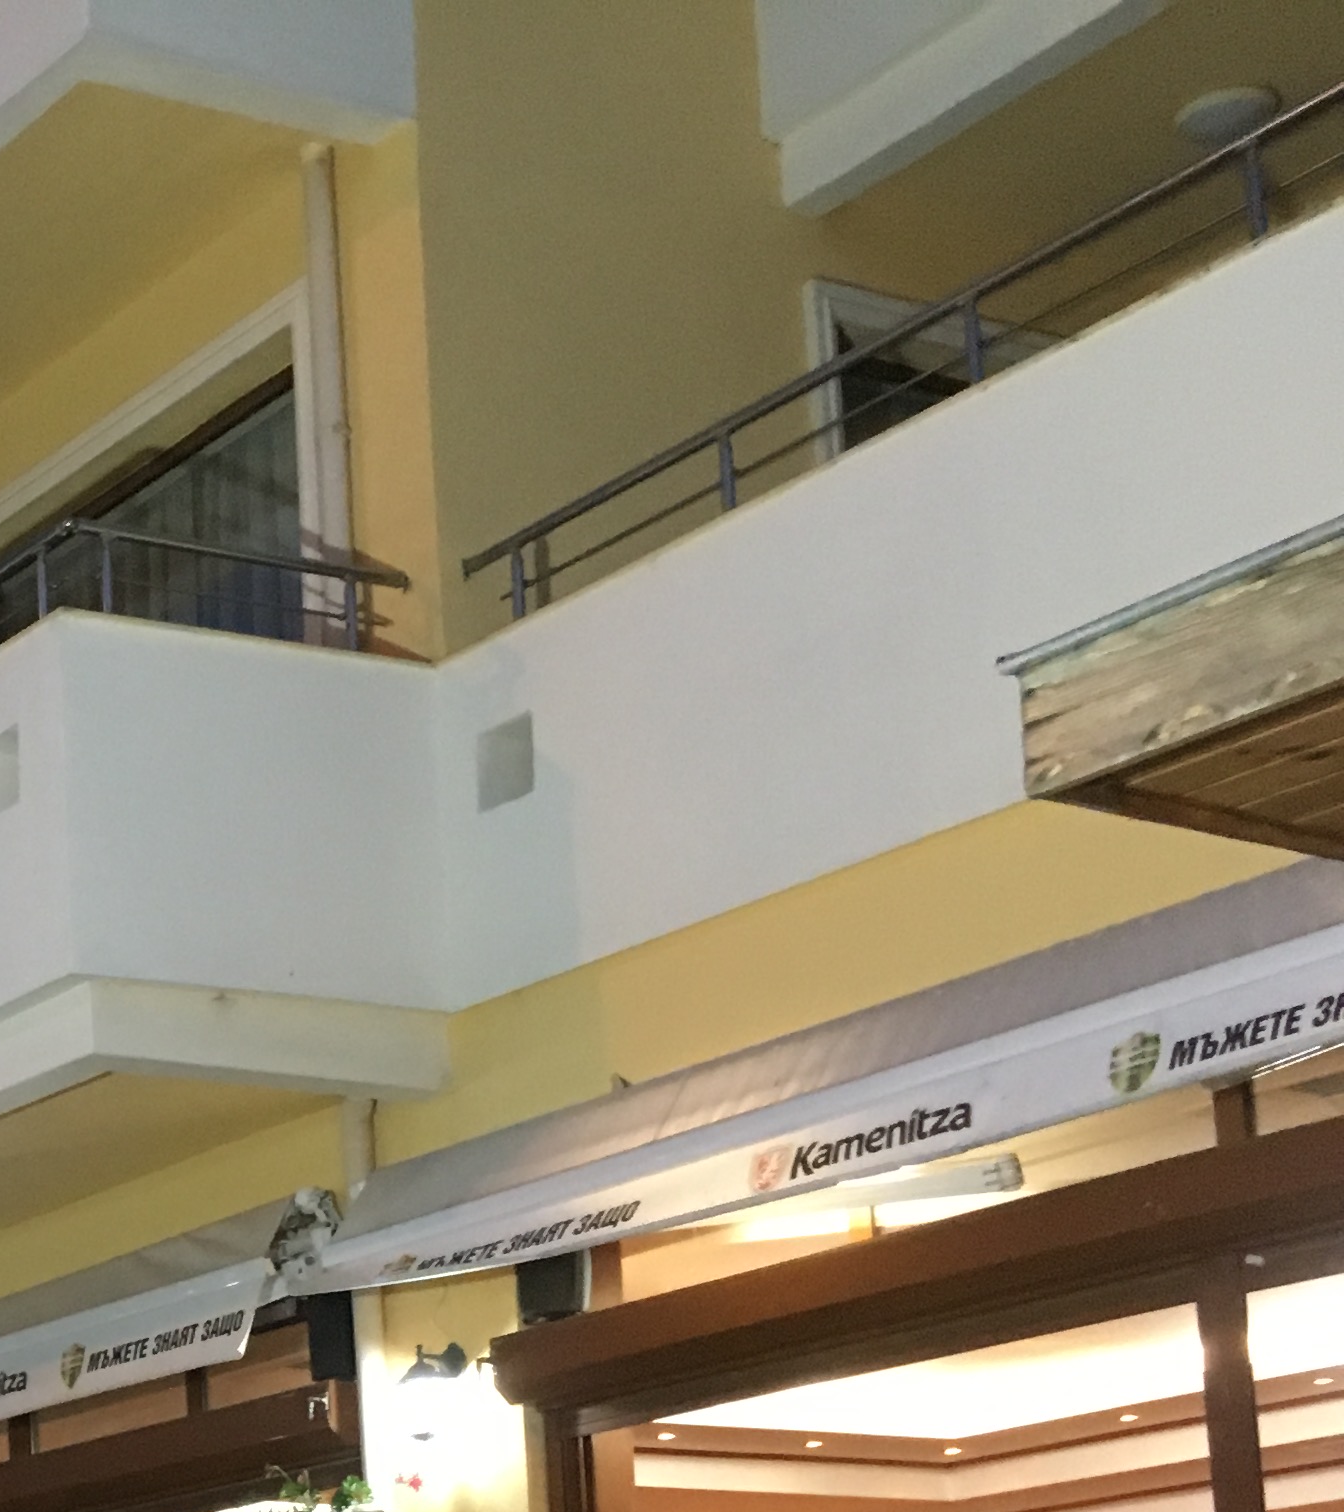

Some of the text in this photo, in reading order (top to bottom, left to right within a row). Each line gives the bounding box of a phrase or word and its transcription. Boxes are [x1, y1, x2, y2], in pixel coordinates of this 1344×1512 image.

[1168, 1006, 1303, 1071] МЪЖЕТЕ
[790, 1100, 972, 1180] Kamenitza
[503, 1218, 575, 1253] ЗНАЯТ
[572, 1200, 641, 1236] ЗАЩО
[87, 1309, 244, 1373] МЪЖЕТЕ ЗНАЯТ ЗАЩО
